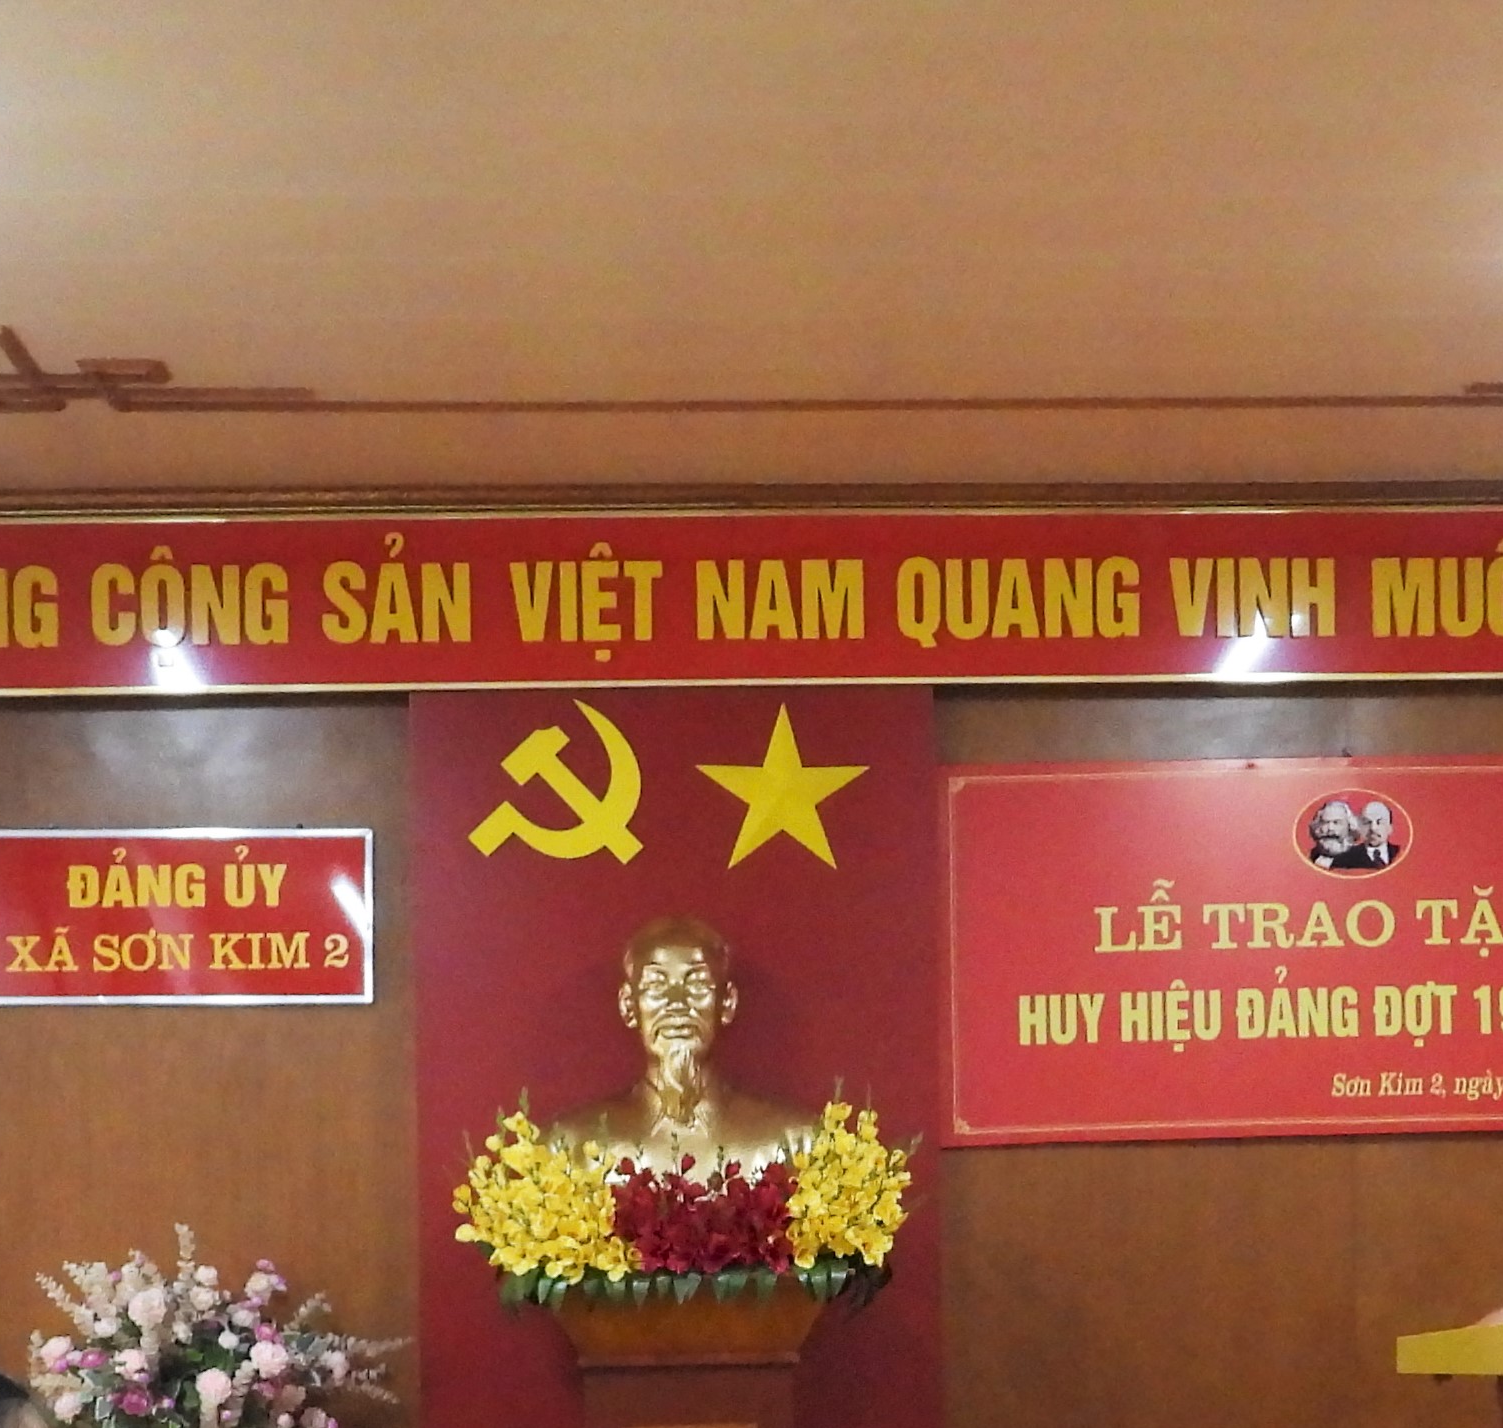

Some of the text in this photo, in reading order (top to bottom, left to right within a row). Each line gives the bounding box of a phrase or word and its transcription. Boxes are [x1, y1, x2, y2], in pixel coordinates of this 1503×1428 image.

[322, 535, 471, 643] SẢN
[510, 543, 662, 661] VIỆT
[697, 560, 864, 639] NAM
[897, 557, 1139, 648] QUANG
[1170, 558, 1335, 638] VINH
[67, 845, 286, 908] ĐẢNG ỦY
[6, 927, 349, 972] XÃ SƠN KIM 2
[1095, 879, 1182, 952] LỄ
[1203, 900, 1395, 949] TRAO
[1019, 994, 1104, 1045] HUY
[1121, 980, 1221, 1052] HIỆU
[1236, 966, 1358, 1038] ĐẢNG
[1373, 981, 1457, 1047] ĐỢT
[1332, 1073, 1371, 1097] Sơn
[1378, 1072, 1423, 1096] Kim
[1430, 1073, 1446, 1097] 2,
